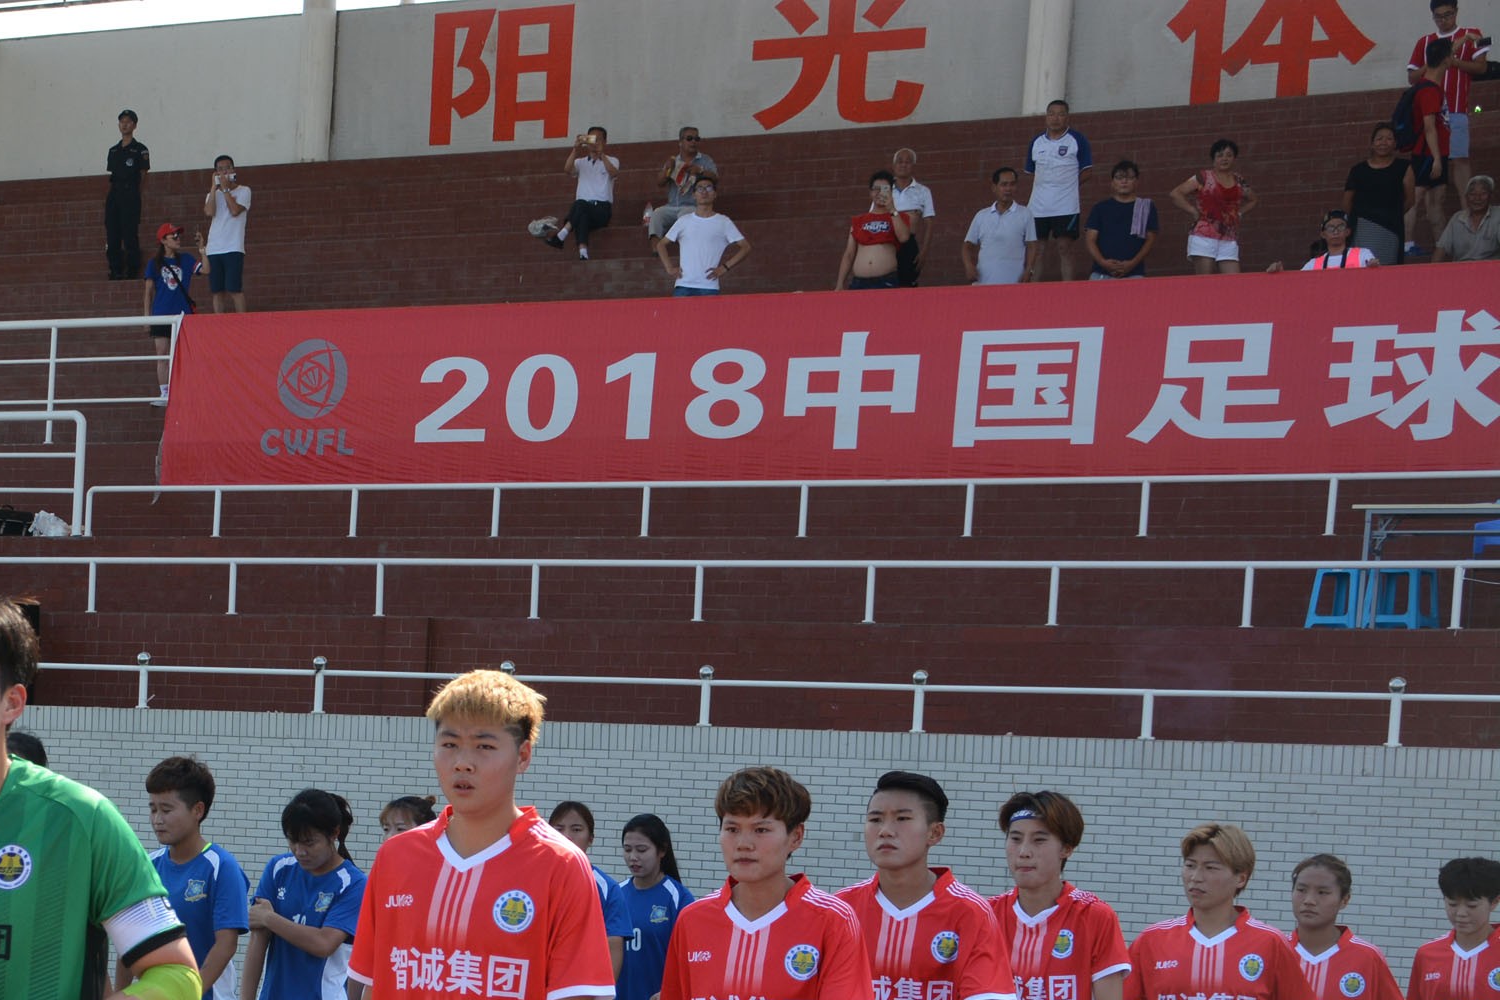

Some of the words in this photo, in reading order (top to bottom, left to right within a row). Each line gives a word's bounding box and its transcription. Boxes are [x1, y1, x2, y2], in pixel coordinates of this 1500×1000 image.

[260, 428, 355, 456] CWFL
[389, 946, 530, 1000] 智诚集团
